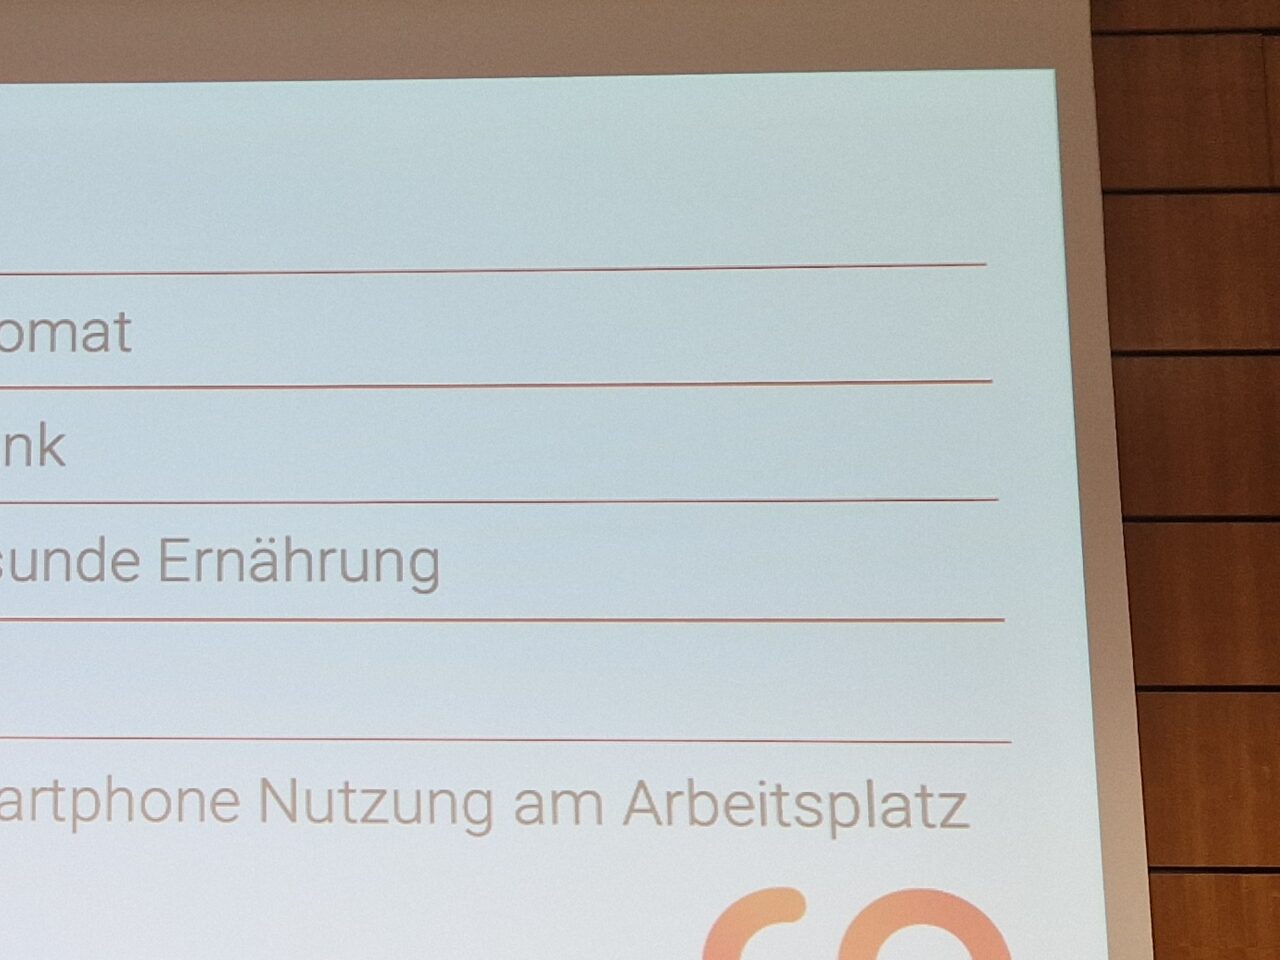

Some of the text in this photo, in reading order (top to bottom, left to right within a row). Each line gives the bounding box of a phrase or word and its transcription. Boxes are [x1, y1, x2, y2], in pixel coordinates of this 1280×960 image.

[161, 536, 439, 595] Ernährung
[261, 778, 492, 838] Nutzung
[516, 790, 603, 826] am
[623, 778, 971, 841] Arbeitsplatz
